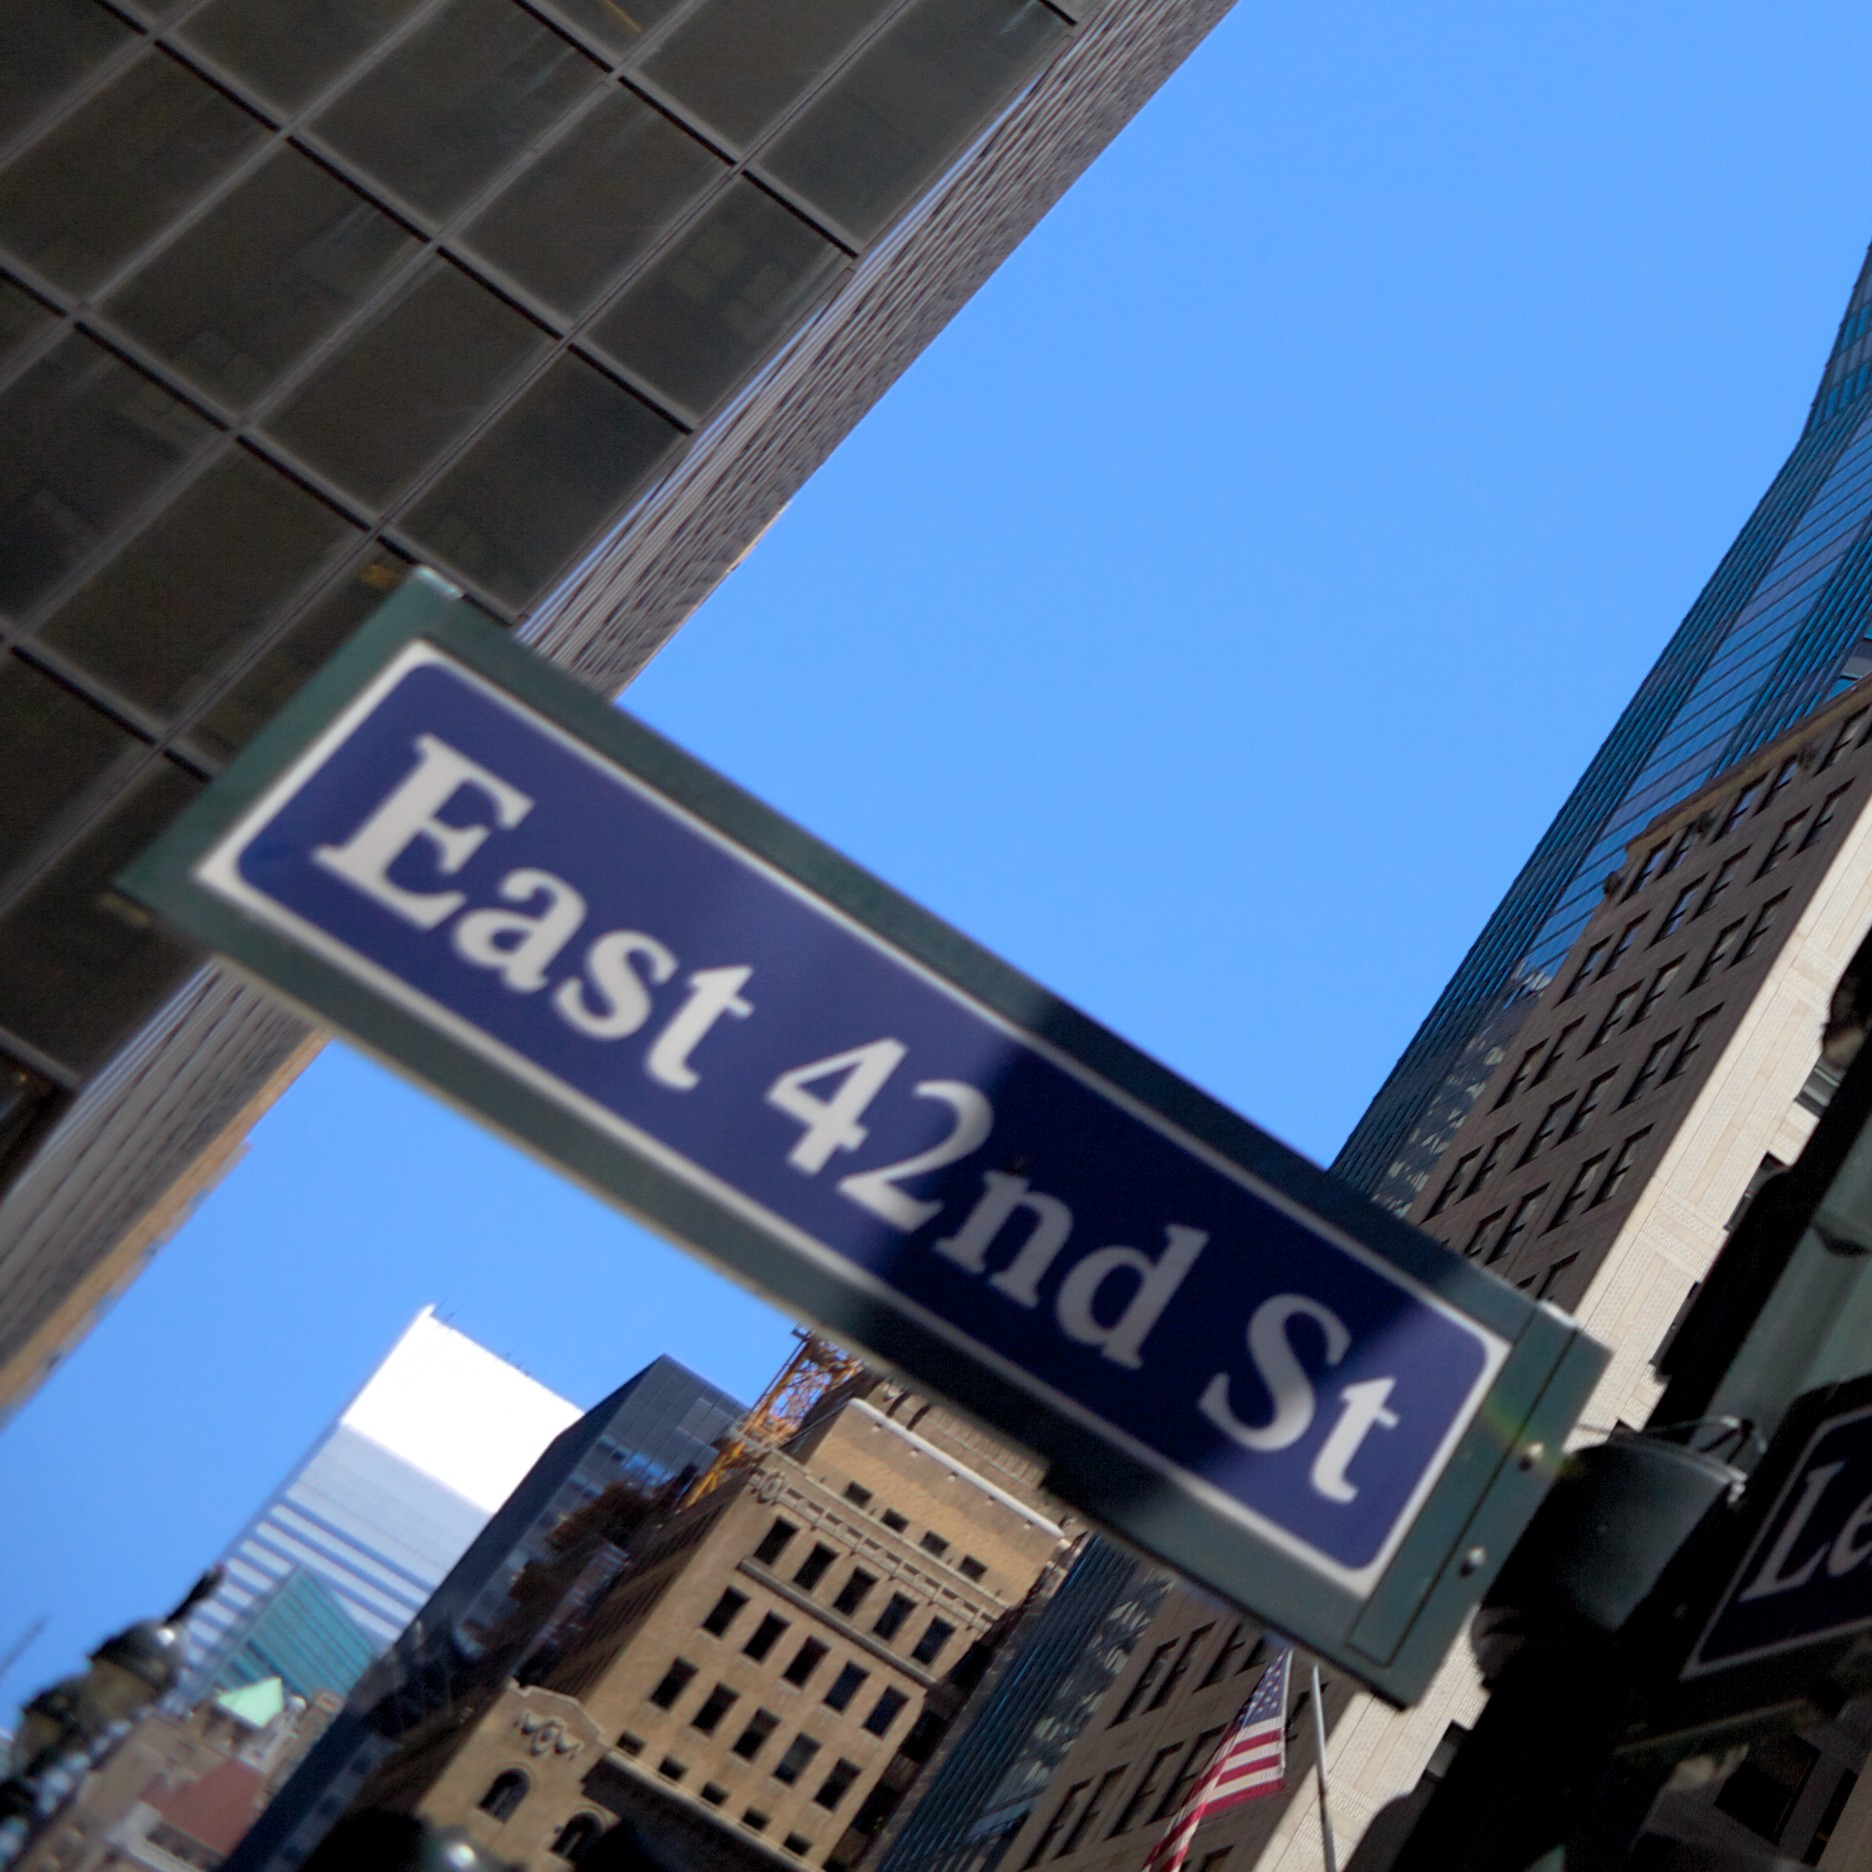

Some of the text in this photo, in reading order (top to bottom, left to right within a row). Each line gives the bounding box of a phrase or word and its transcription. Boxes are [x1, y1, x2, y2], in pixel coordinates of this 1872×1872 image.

[314, 733, 1400, 1502] East 42nd St
